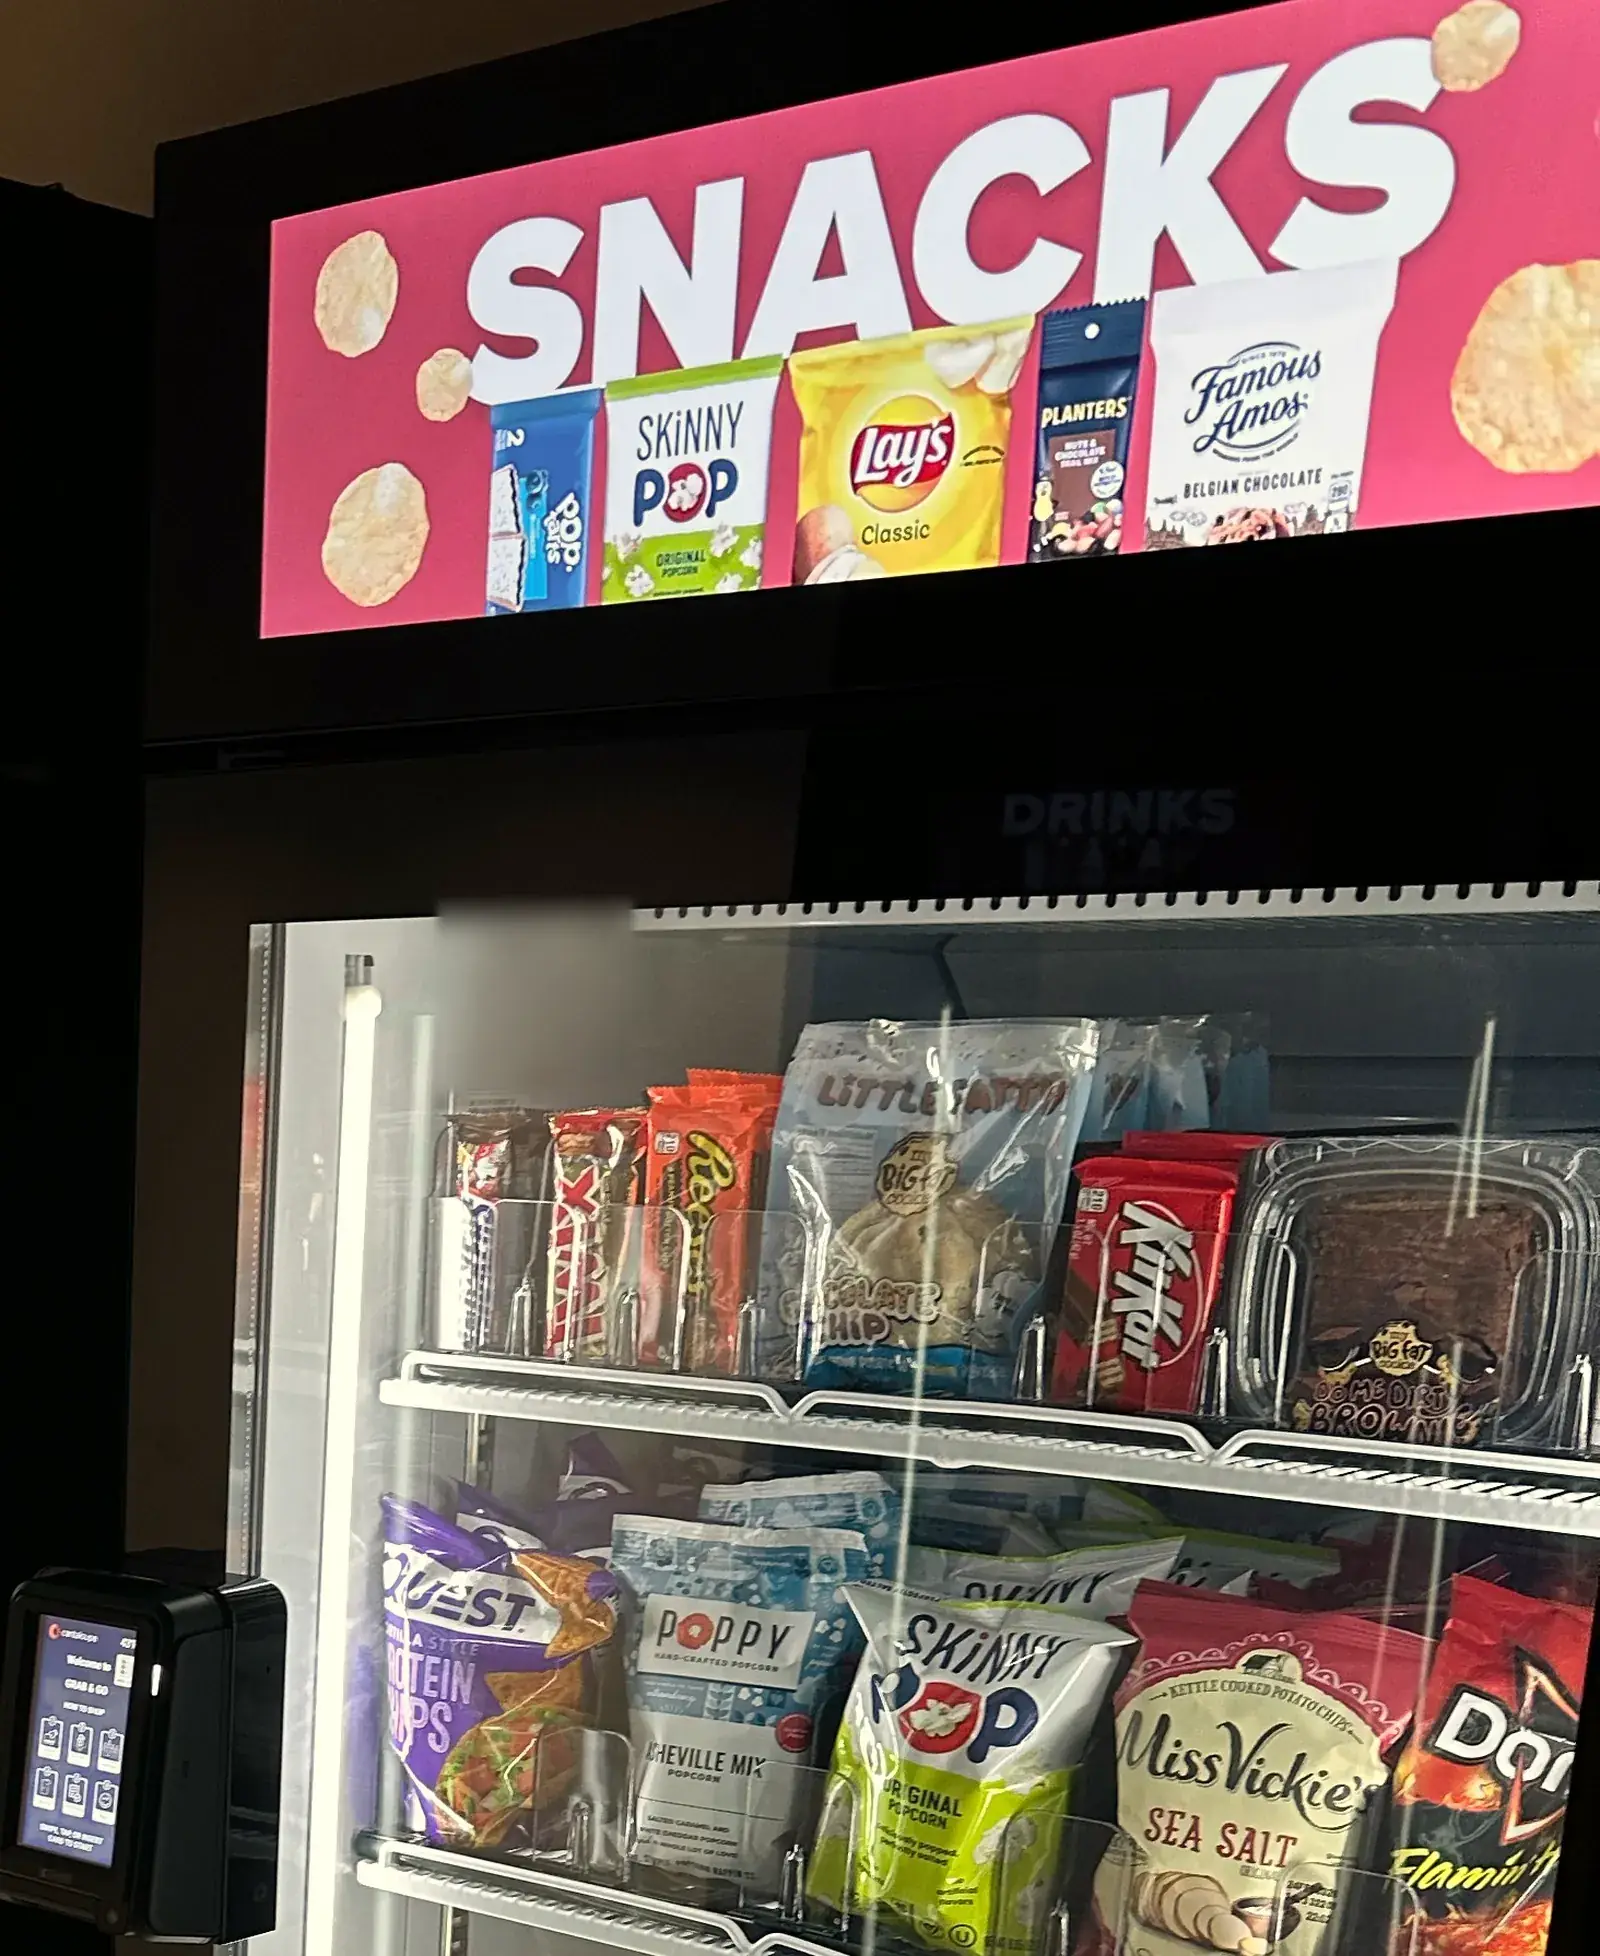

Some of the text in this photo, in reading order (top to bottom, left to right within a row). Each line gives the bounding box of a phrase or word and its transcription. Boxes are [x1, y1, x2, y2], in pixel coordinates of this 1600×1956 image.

[467, 36, 1457, 406] SNACKS
[1184, 350, 1322, 424] Famous
[1041, 398, 1129, 429] PLANTERS
[1193, 391, 1306, 453] Amos
[506, 427, 526, 448] 2
[853, 420, 952, 489] Lay's
[1054, 446, 1106, 462] CHOCOLATE
[633, 458, 739, 528] POP
[1183, 479, 1239, 499] BELGIAN
[1243, 467, 1323, 493] CHOCOLATE
[861, 519, 931, 545] Classic
[656, 549, 707, 567] ORIGINAL
[1002, 788, 1238, 837] DRINKS
[427, 1635, 480, 1656] STYLE
[656, 1609, 792, 1660] POPPY
[387, 1641, 476, 1704] ROTEIN
[654, 1652, 779, 1673] HAND-CRAFTED POPCORN
[1169, 1679, 1351, 1732] KETTLE COOKED POTATO CHIPS
[646, 1740, 766, 1779] HEVILLE MIX
[667, 1768, 722, 1783] POPCORN
[1117, 1709, 1368, 1831] Miss Vickie'
[883, 1778, 963, 1817] ORGINAL
[888, 1798, 947, 1830] POPCORN
[1144, 1806, 1299, 1868] SEA SALT
